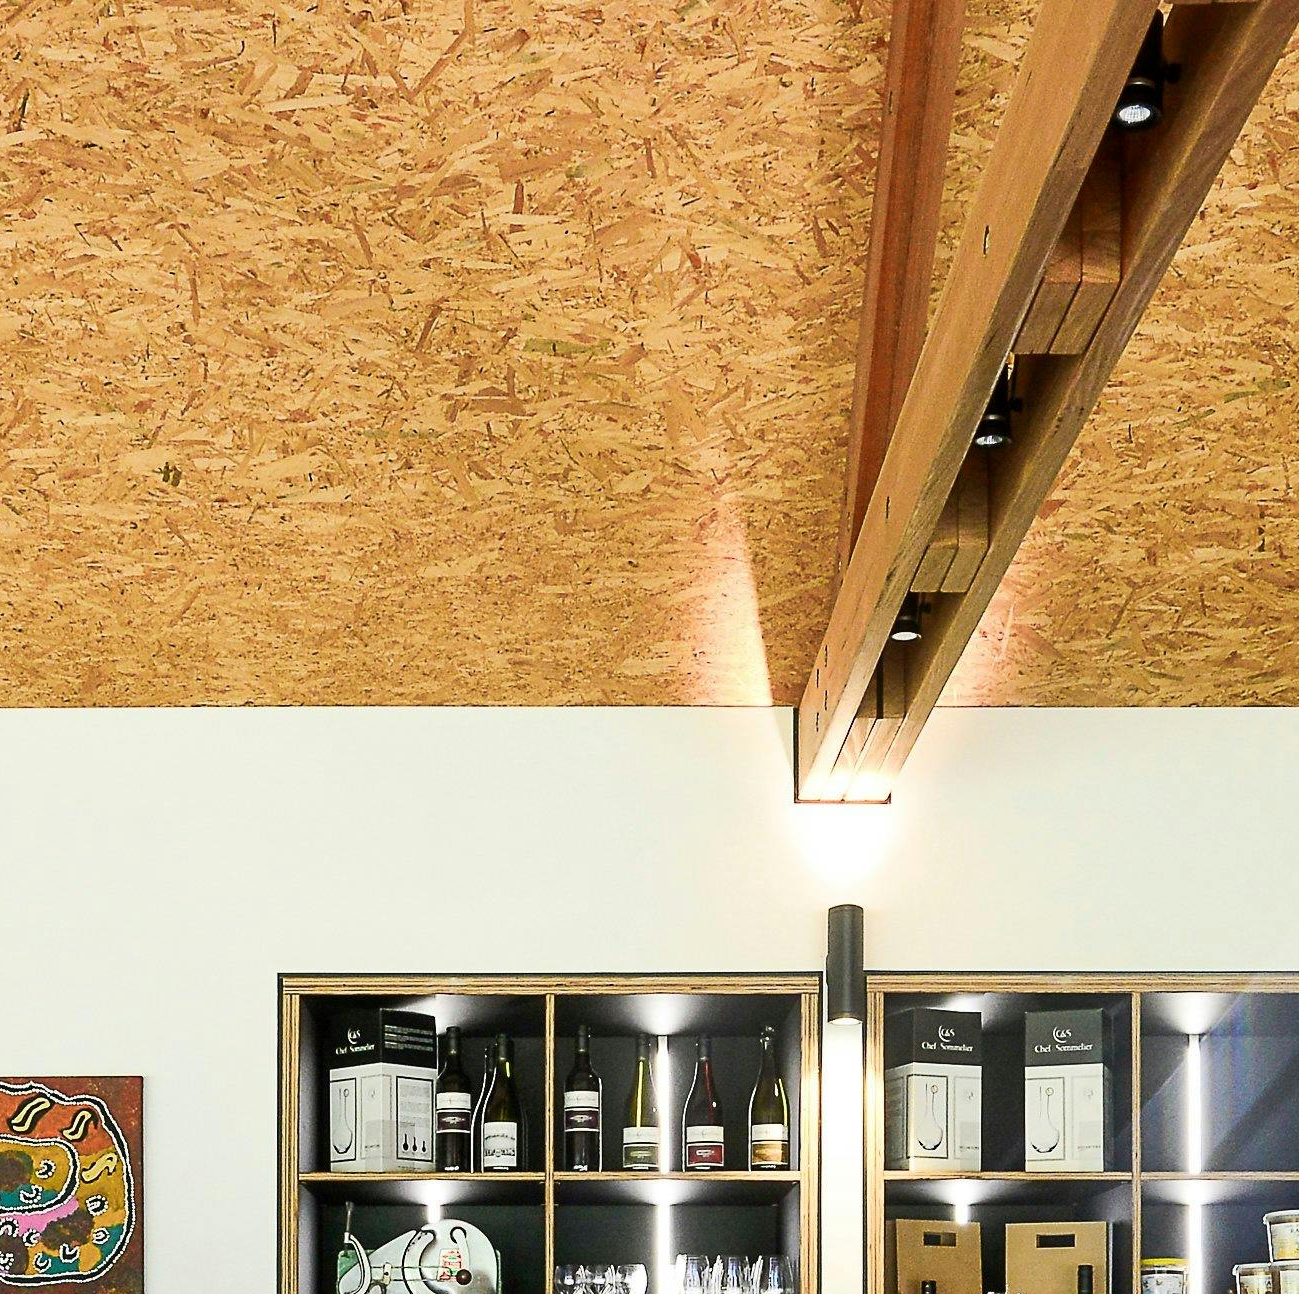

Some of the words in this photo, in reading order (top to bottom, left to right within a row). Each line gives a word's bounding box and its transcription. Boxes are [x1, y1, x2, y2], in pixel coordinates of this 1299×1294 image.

[921, 1041, 937, 1050] Chef
[1034, 1044, 1051, 1053] Chef
[1055, 1043, 1093, 1052] Sommelier
